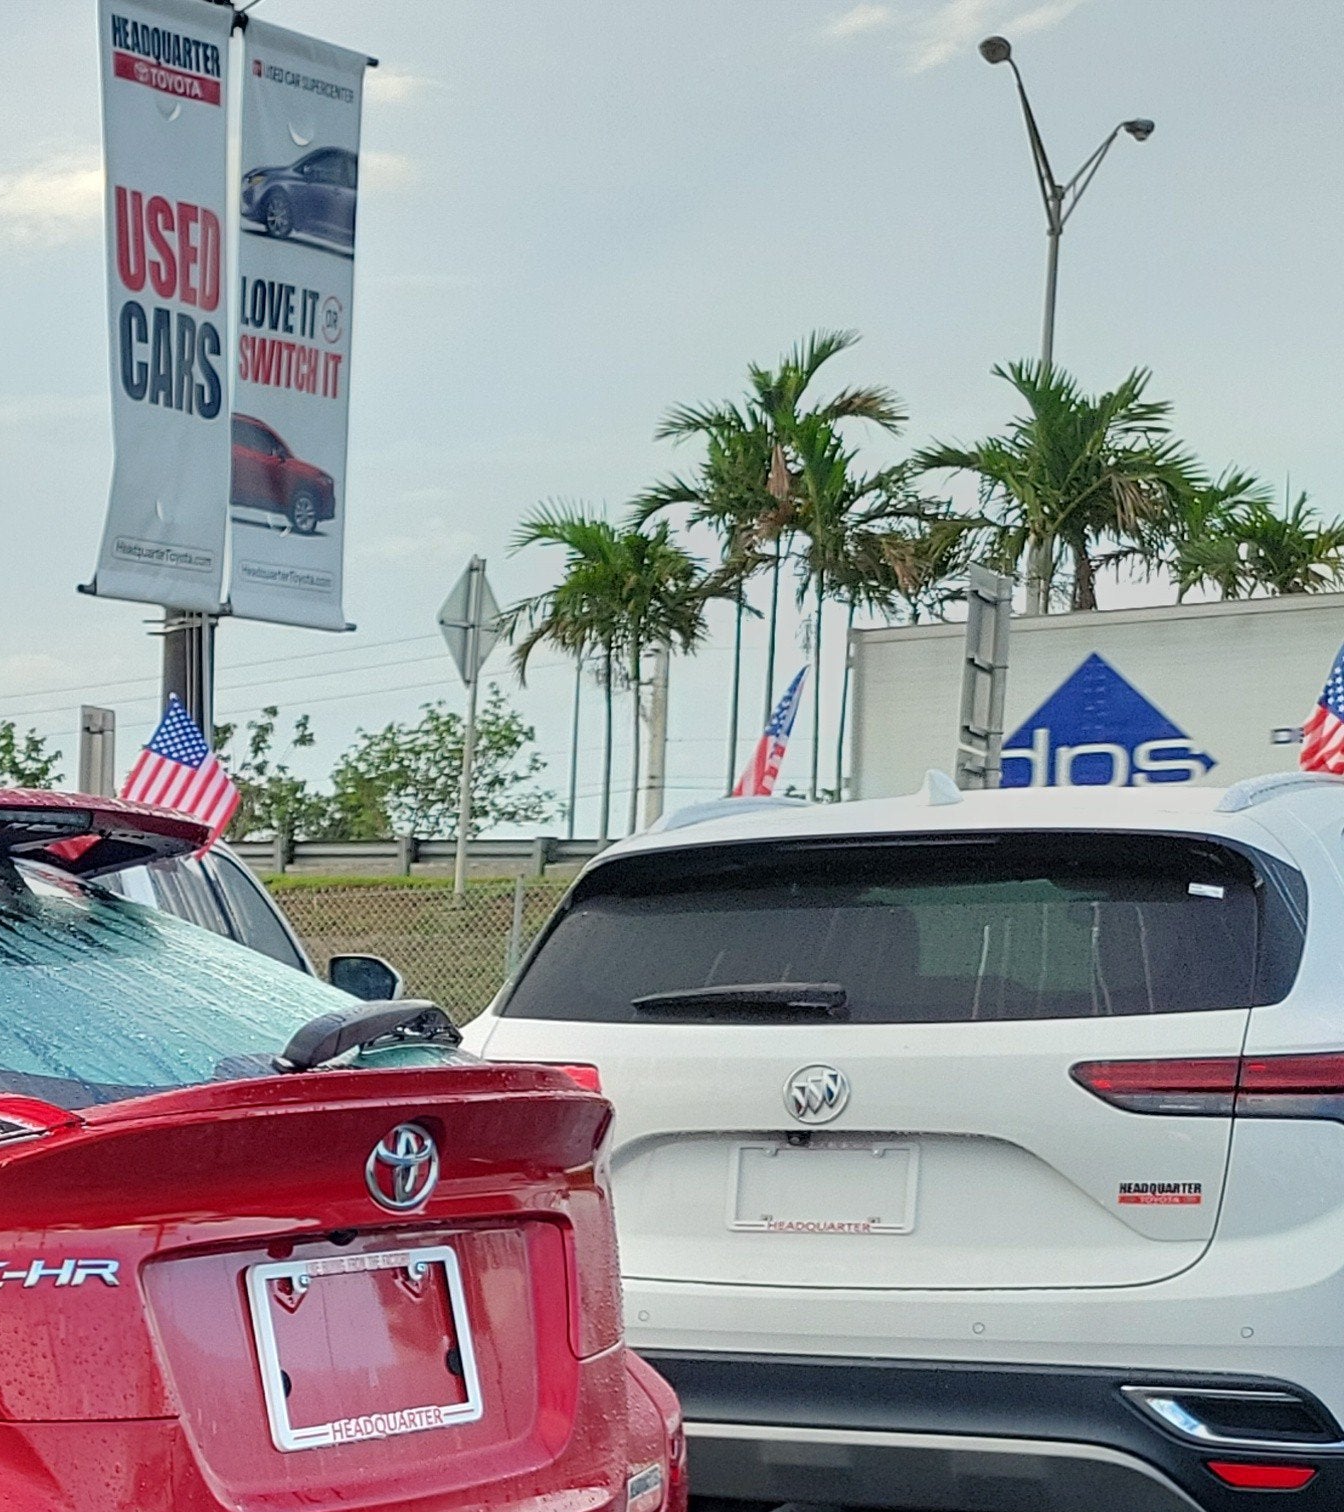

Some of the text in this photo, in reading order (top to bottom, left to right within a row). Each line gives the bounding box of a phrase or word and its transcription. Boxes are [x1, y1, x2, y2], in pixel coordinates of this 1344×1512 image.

[111, 13, 221, 78] HEADQUARTER
[150, 67, 202, 98] TOYOTA
[114, 185, 220, 312] USED
[240, 276, 295, 334] LOVE
[300, 288, 319, 339] IT
[118, 300, 222, 420] CARS
[238, 334, 342, 399] SWITCH IT
[1119, 1183, 1202, 1196] HEADQUARTER
[768, 1220, 871, 1234] HEADQUARTER
[332, 1408, 444, 1441] HEADQUARTER
